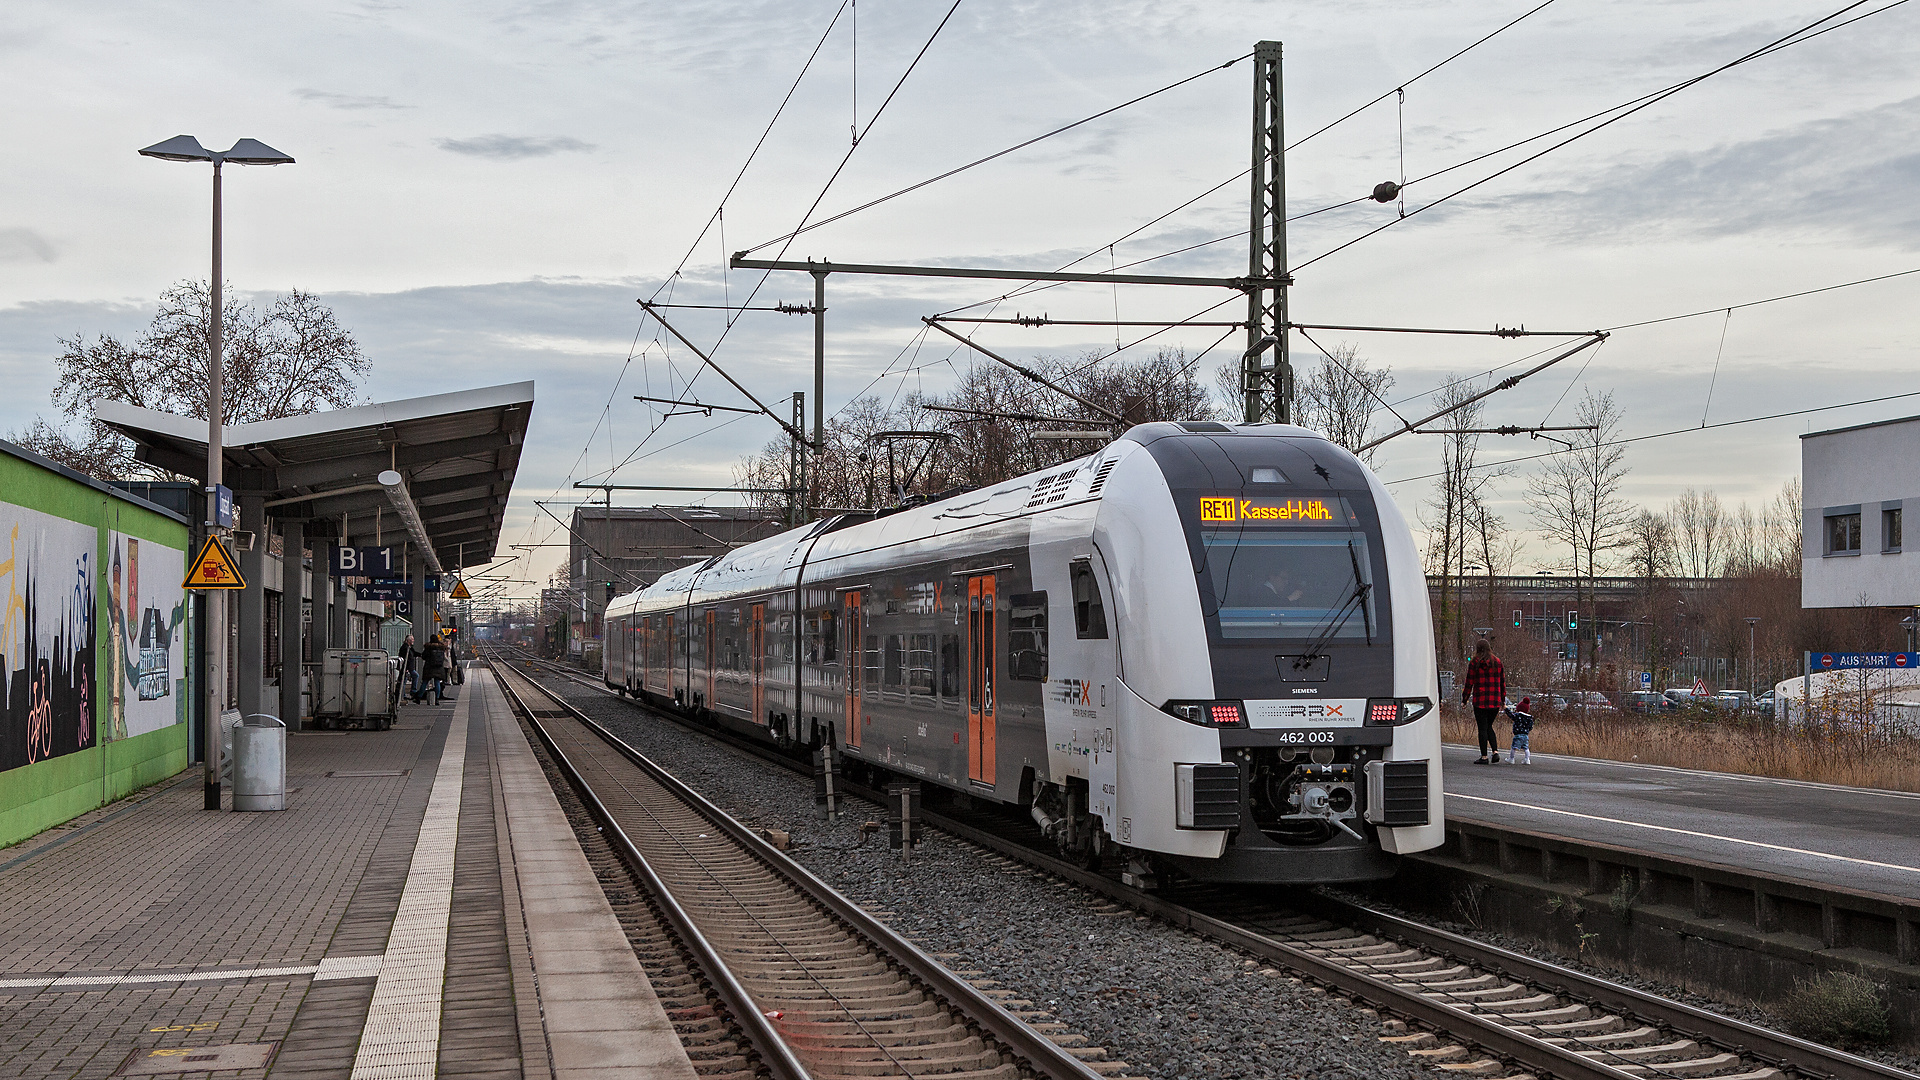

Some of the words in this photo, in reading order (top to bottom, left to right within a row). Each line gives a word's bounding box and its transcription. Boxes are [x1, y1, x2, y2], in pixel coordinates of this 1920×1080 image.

[1202, 500, 1234, 519] RE11
[1240, 500, 1333, 520] Kassel-Wilh.
[339, 547, 357, 570] B
[380, 547, 390, 570] 1
[398, 601, 407, 613] C
[1839, 655, 1890, 666] AUSFAHRT
[1643, 673, 1650, 682] P
[1283, 704, 1343, 717] RRX
[1279, 732, 1305, 743] 462
[1308, 731, 1335, 743] 003
